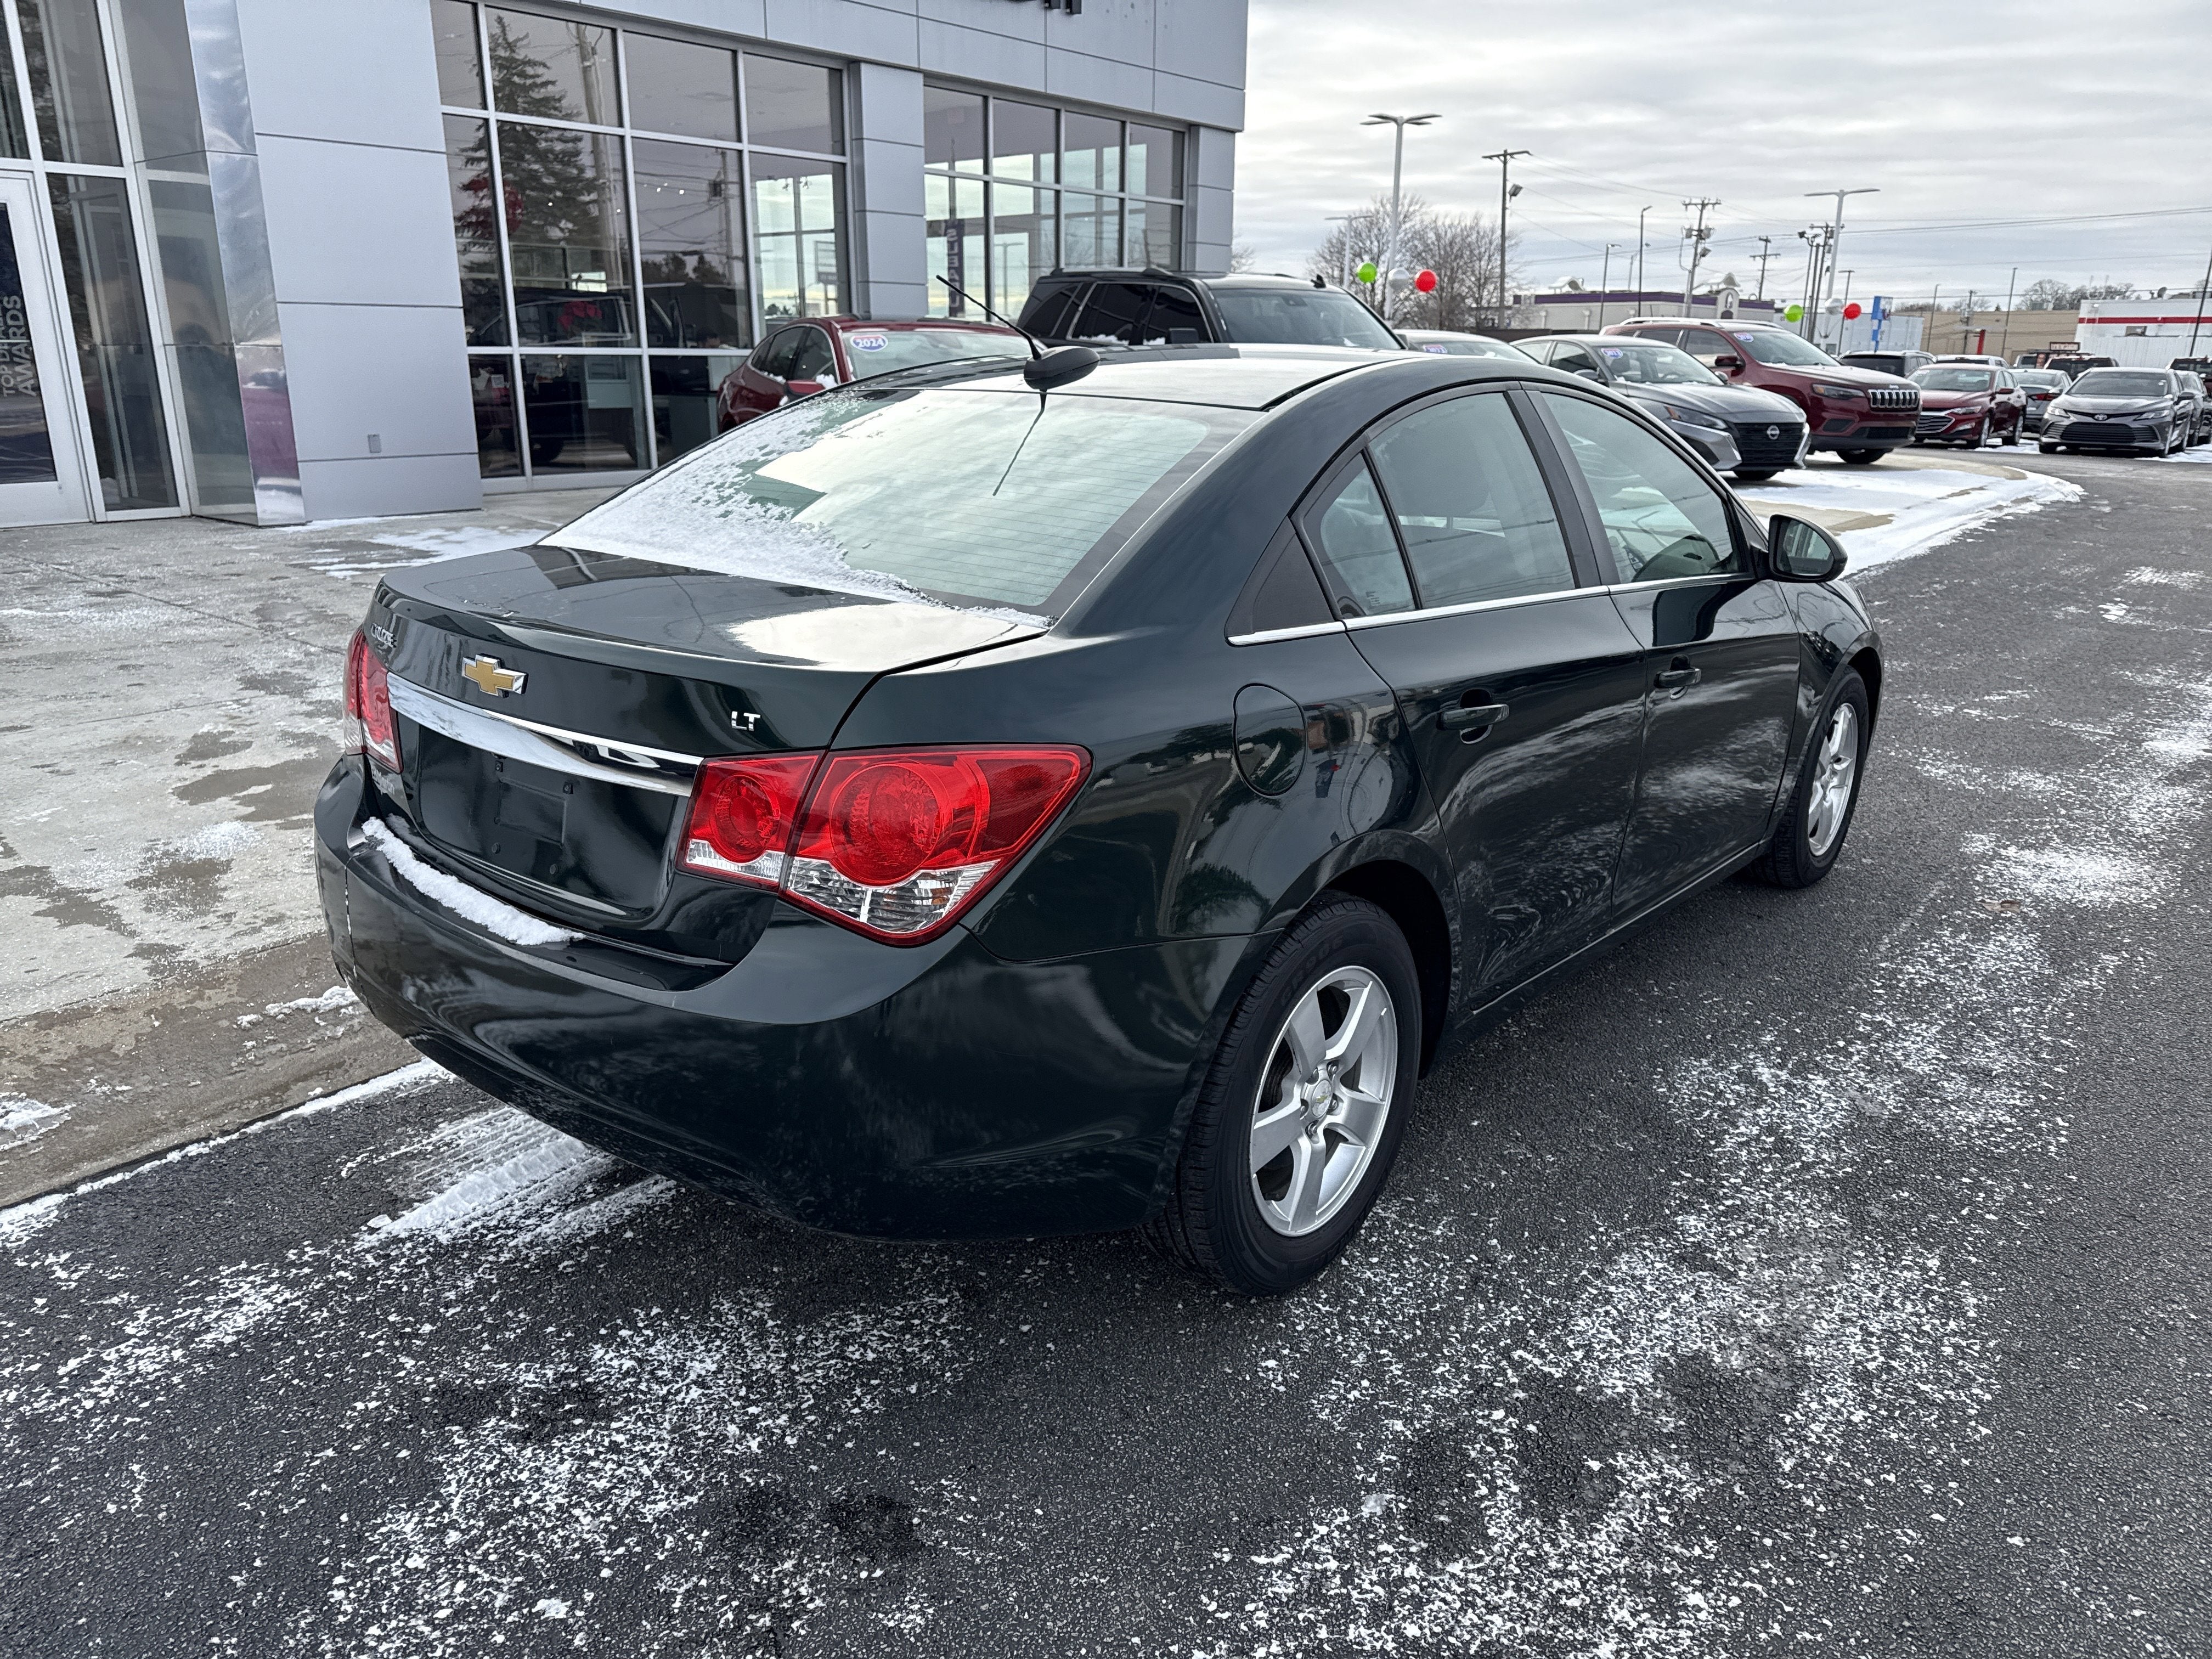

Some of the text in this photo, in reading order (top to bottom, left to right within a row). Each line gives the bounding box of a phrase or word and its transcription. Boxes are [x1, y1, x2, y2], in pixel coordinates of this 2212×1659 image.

[3, 295, 37, 397] AWARDS
[855, 337, 884, 347] 2024
[0, 364, 15, 397] TOP
[731, 711, 761, 731] LT
